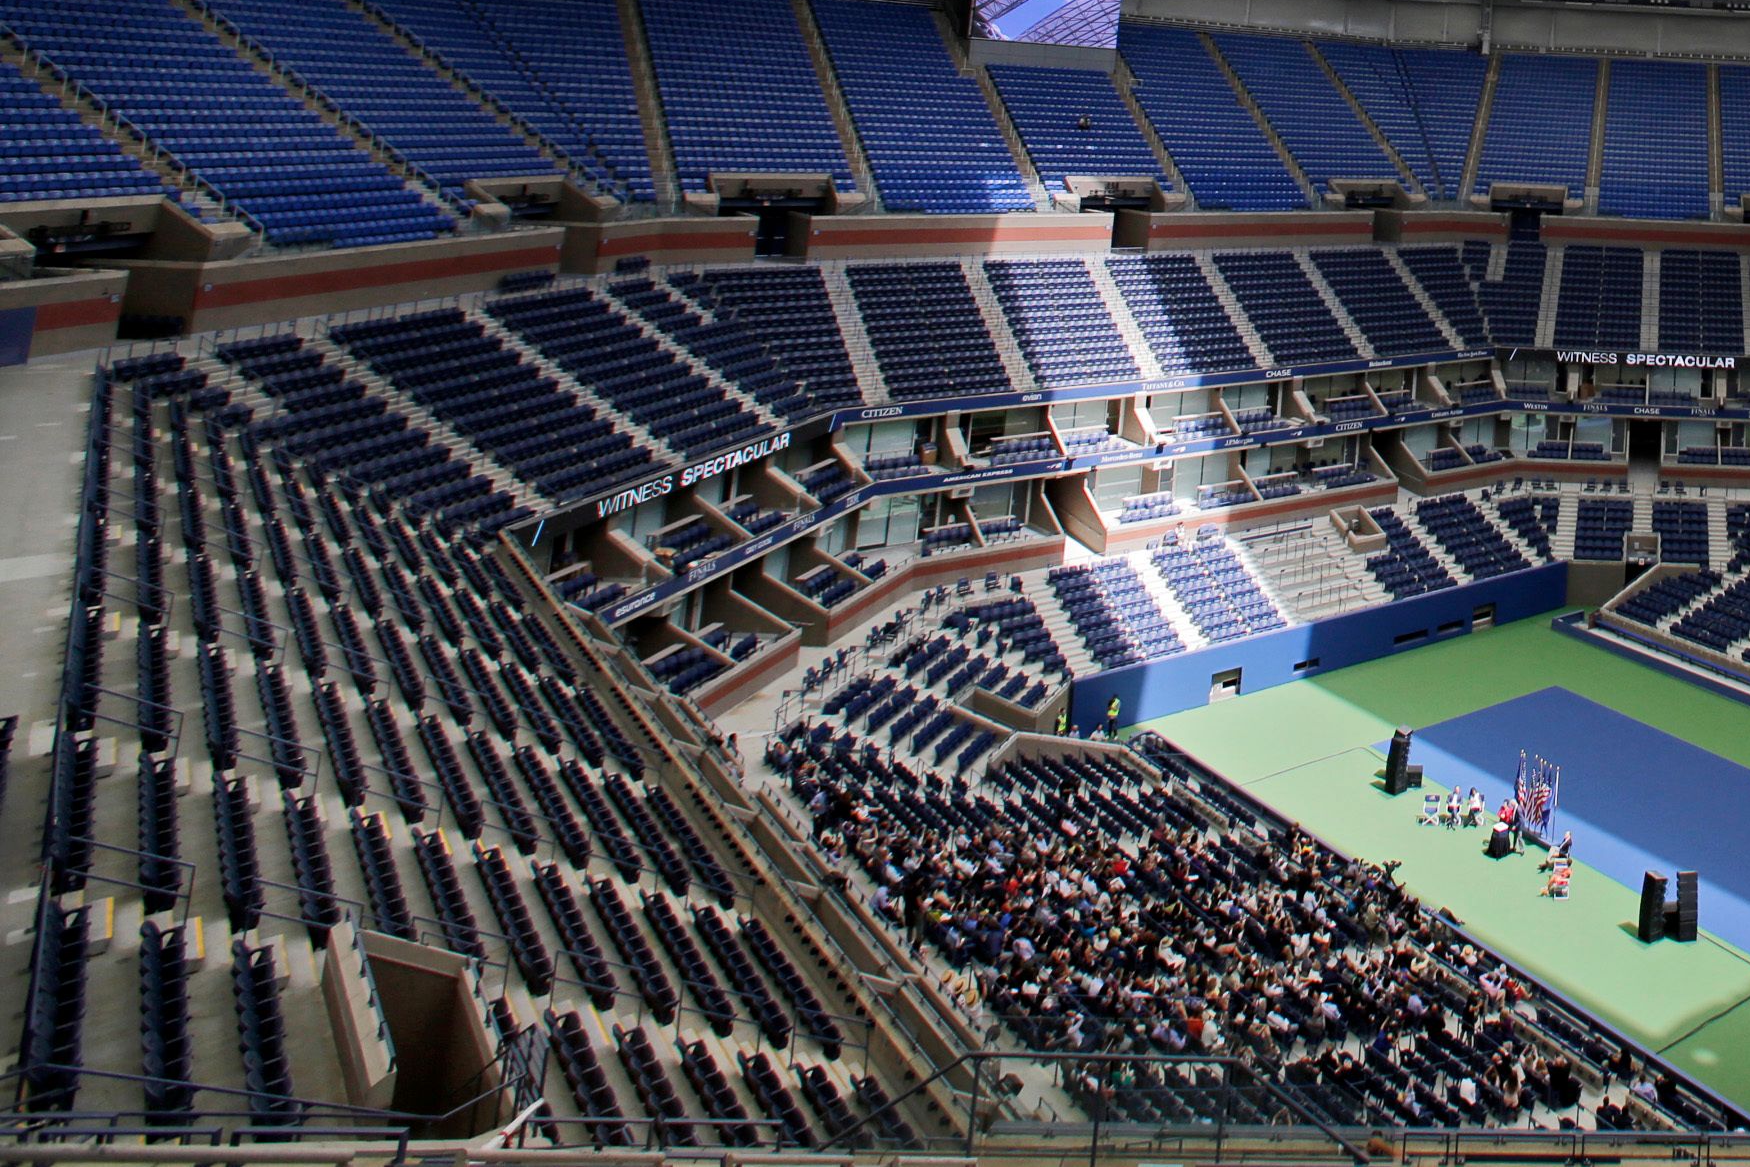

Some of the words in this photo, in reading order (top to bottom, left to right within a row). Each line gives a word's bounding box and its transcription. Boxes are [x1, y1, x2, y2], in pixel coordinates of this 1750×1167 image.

[1557, 351, 1618, 364] WITNESS
[1626, 353, 1735, 369] SPECTACULAR
[1265, 368, 1292, 378] CHASE
[1022, 393, 1042, 402] evian
[861, 406, 903, 419] CITIZEN
[1633, 407, 1660, 415] CHASE
[1335, 421, 1363, 432] CITIZEN
[597, 476, 673, 518] WITNESS
[680, 432, 790, 487] SPECTACULAR
[943, 473, 982, 483] AMERICAN
[982, 468, 1013, 478] EXPRESS
[688, 560, 716, 582] FINALS
[615, 592, 656, 618] esurance
